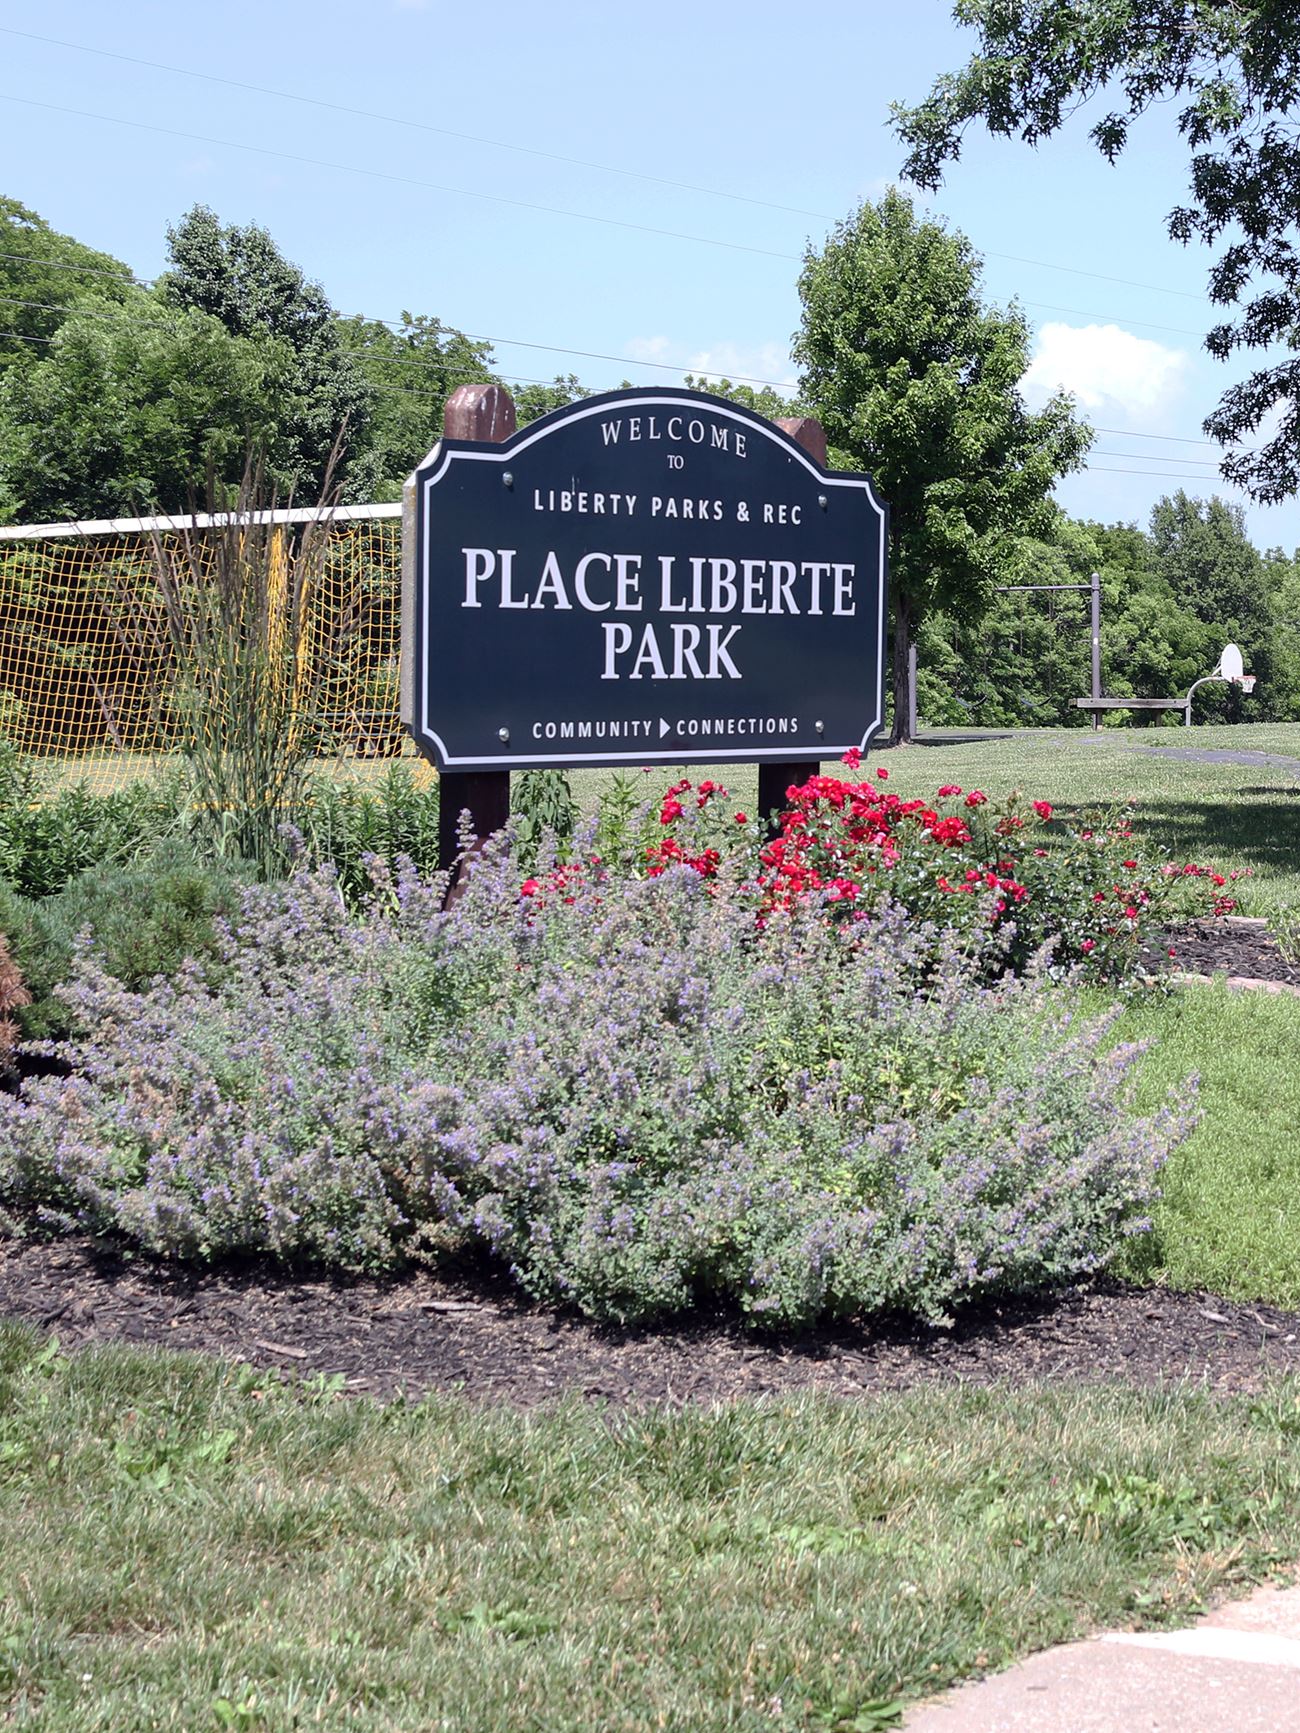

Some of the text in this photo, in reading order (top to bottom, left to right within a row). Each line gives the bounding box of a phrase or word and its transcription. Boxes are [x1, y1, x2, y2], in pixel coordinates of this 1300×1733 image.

[601, 416, 748, 459] WELCOME
[666, 454, 684, 470] TO
[534, 489, 802, 525] LIBERTY PARKS & REC
[460, 547, 856, 616] PLACE LIBERTE
[600, 622, 743, 680] PARK
[532, 717, 798, 739] COMMUNITY CONNECTIONS
